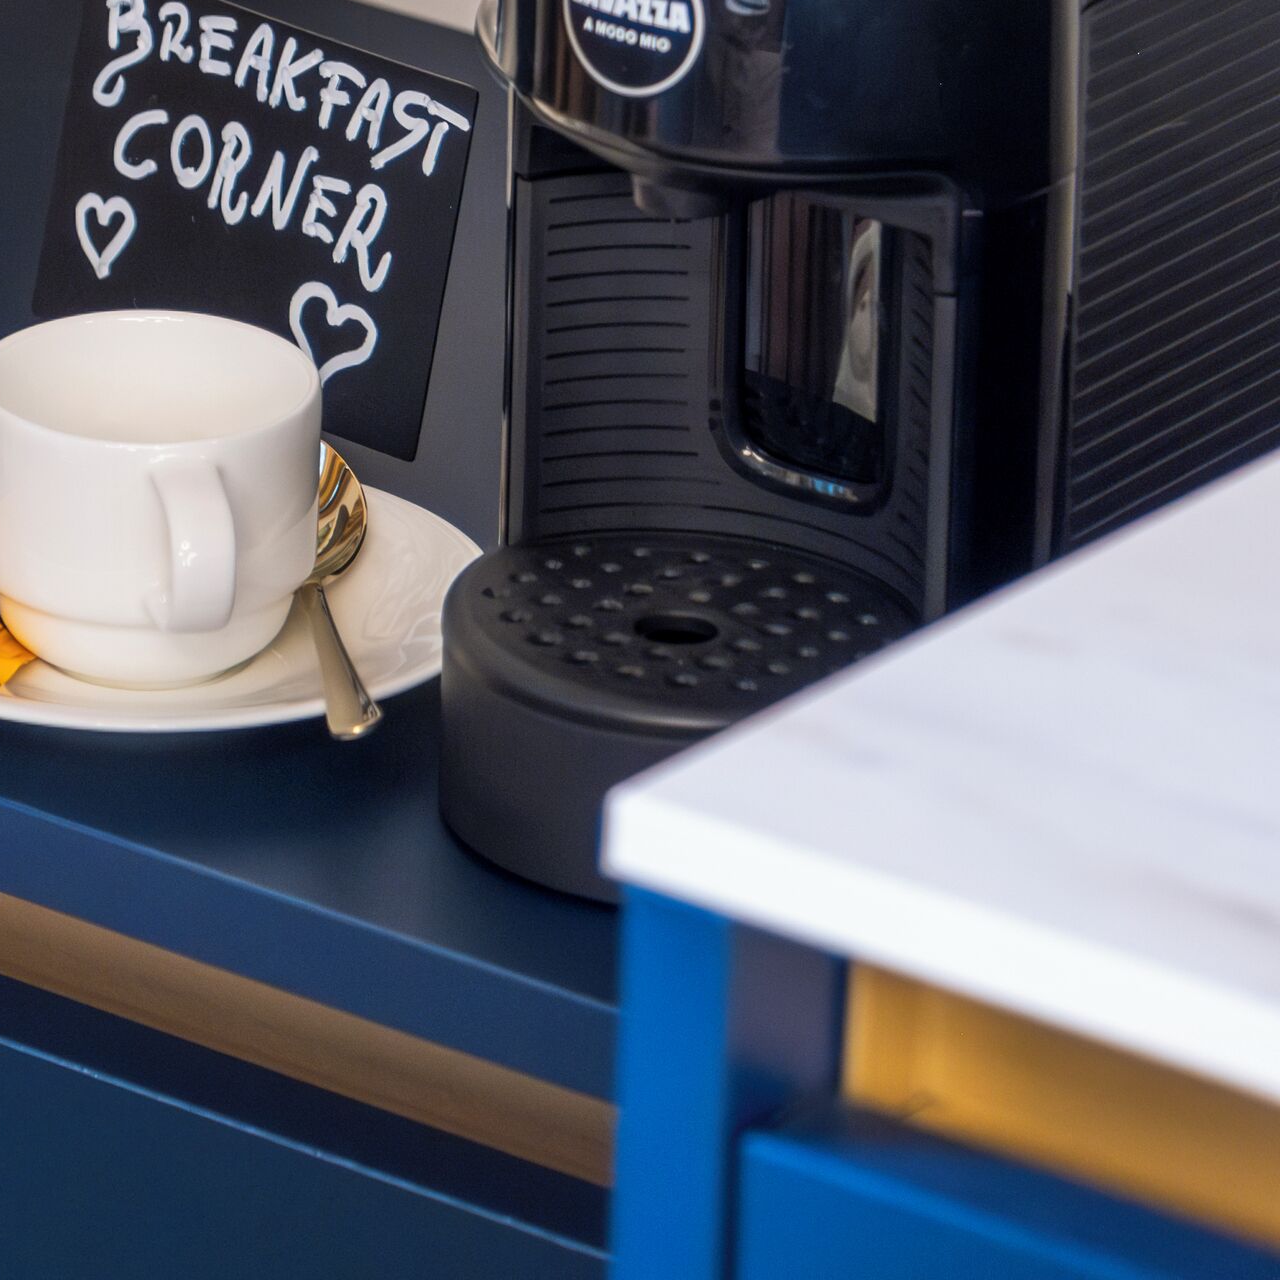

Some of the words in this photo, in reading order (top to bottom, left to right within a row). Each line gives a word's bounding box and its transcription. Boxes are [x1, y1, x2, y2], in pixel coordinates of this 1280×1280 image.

[583, 15, 594, 33] A
[595, 18, 638, 46] MODO
[639, 32, 672, 54] MIO
[113, 108, 393, 293] CORNER
